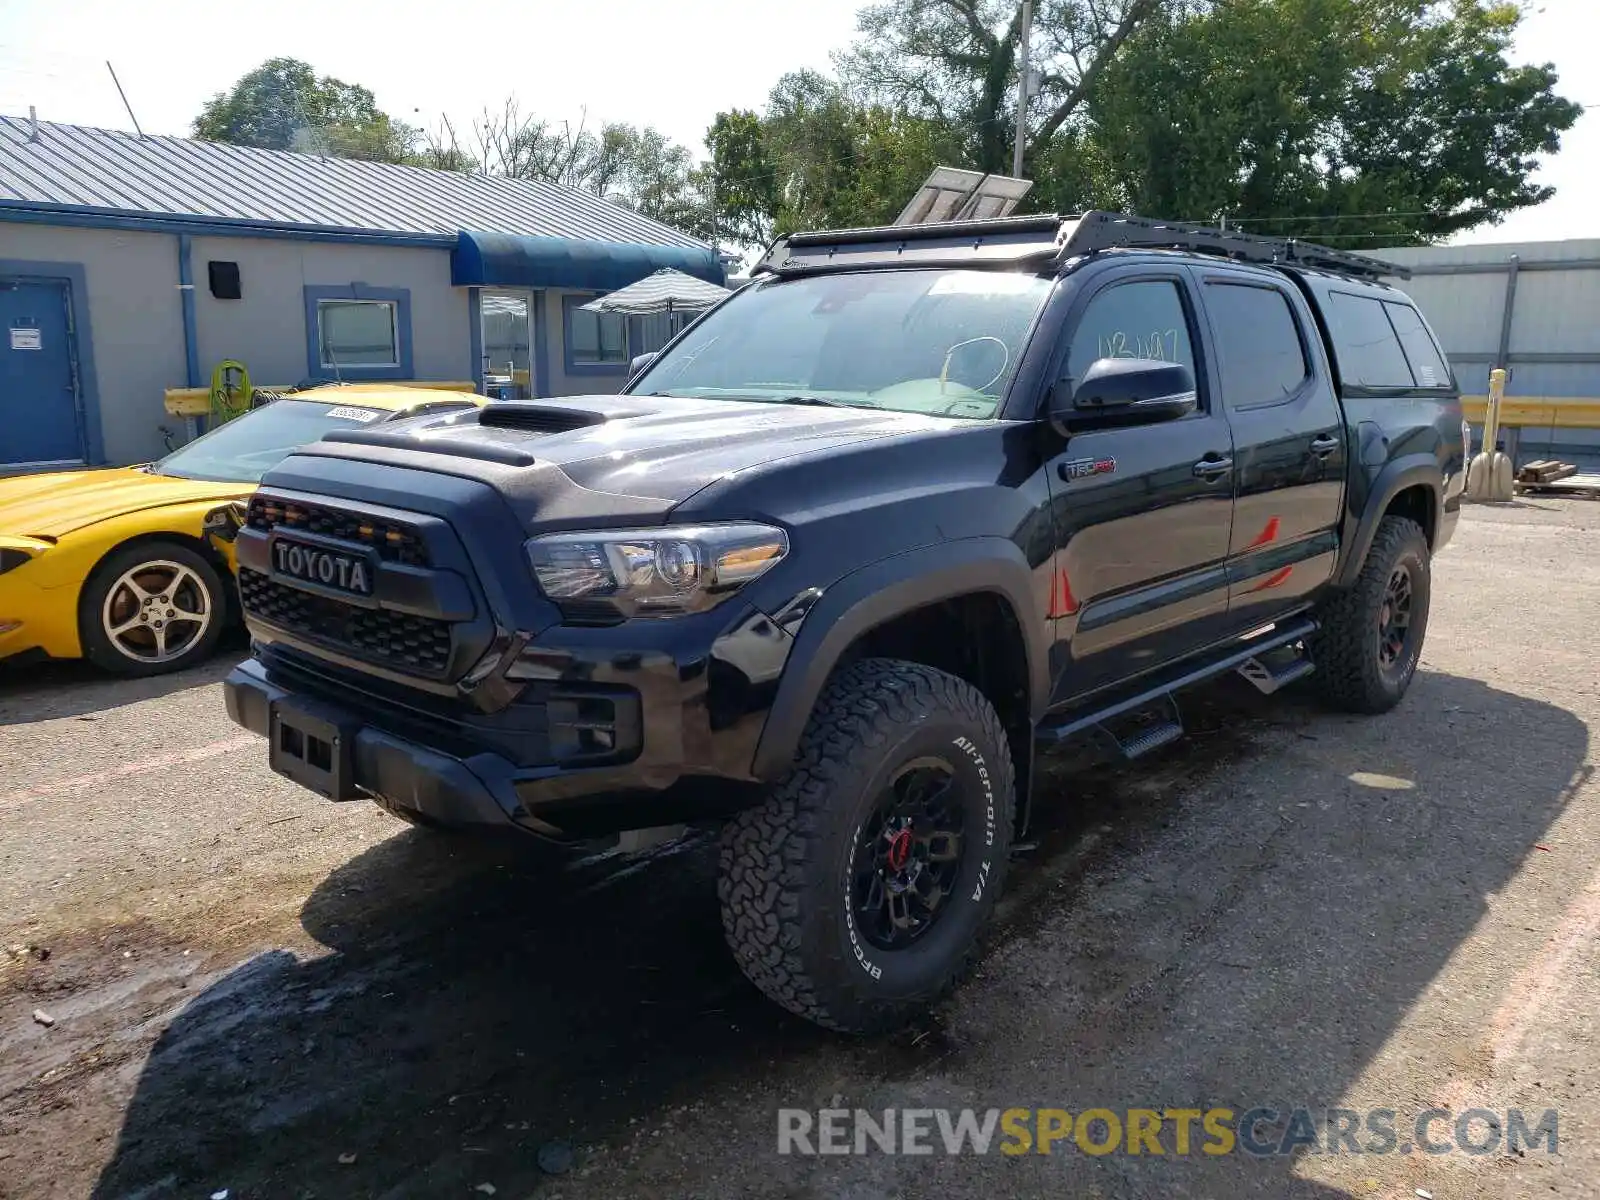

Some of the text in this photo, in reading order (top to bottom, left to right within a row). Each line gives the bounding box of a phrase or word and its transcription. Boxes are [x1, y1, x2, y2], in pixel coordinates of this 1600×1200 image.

[275, 542, 369, 592] TOYOTA
[952, 736, 994, 901] All-Terrain T/A
